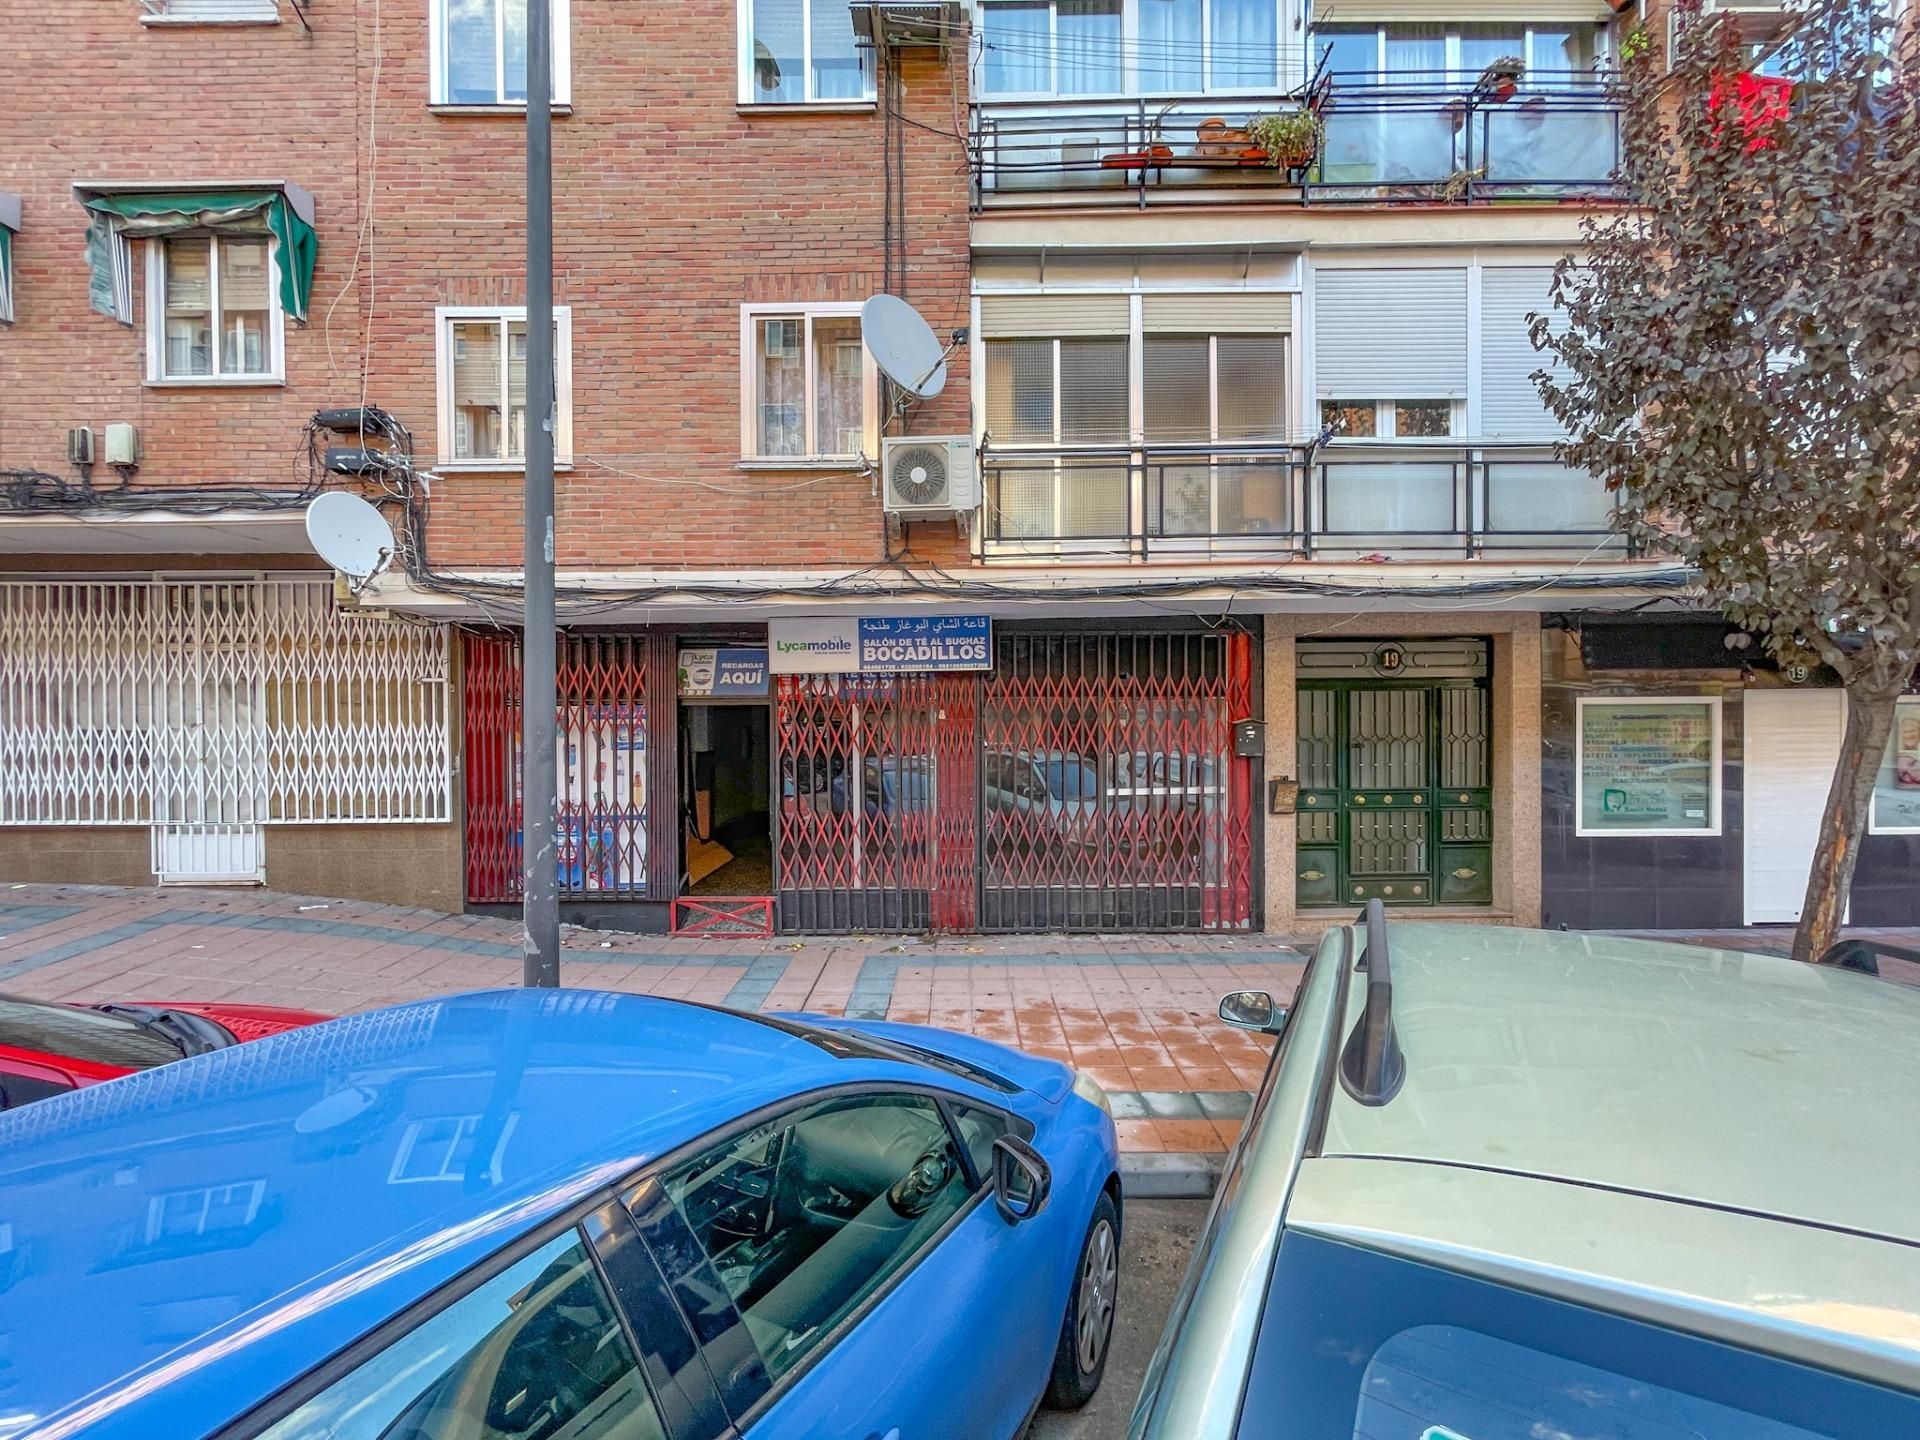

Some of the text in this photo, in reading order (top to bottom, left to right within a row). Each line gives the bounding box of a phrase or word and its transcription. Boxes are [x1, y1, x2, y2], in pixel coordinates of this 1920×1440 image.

[863, 619, 891, 632] طنجة
[933, 618, 960, 633] الشاي
[963, 617, 986, 628] قاعة
[776, 639, 852, 654] Lycamobile
[863, 637, 986, 647] SALÓN DE TÉ AL BUGHAZ
[863, 645, 987, 661] BOCADILLOS
[1383, 652, 1399, 667] 19
[720, 669, 763, 685] AQUÍ
[1789, 666, 1805, 679] 19
